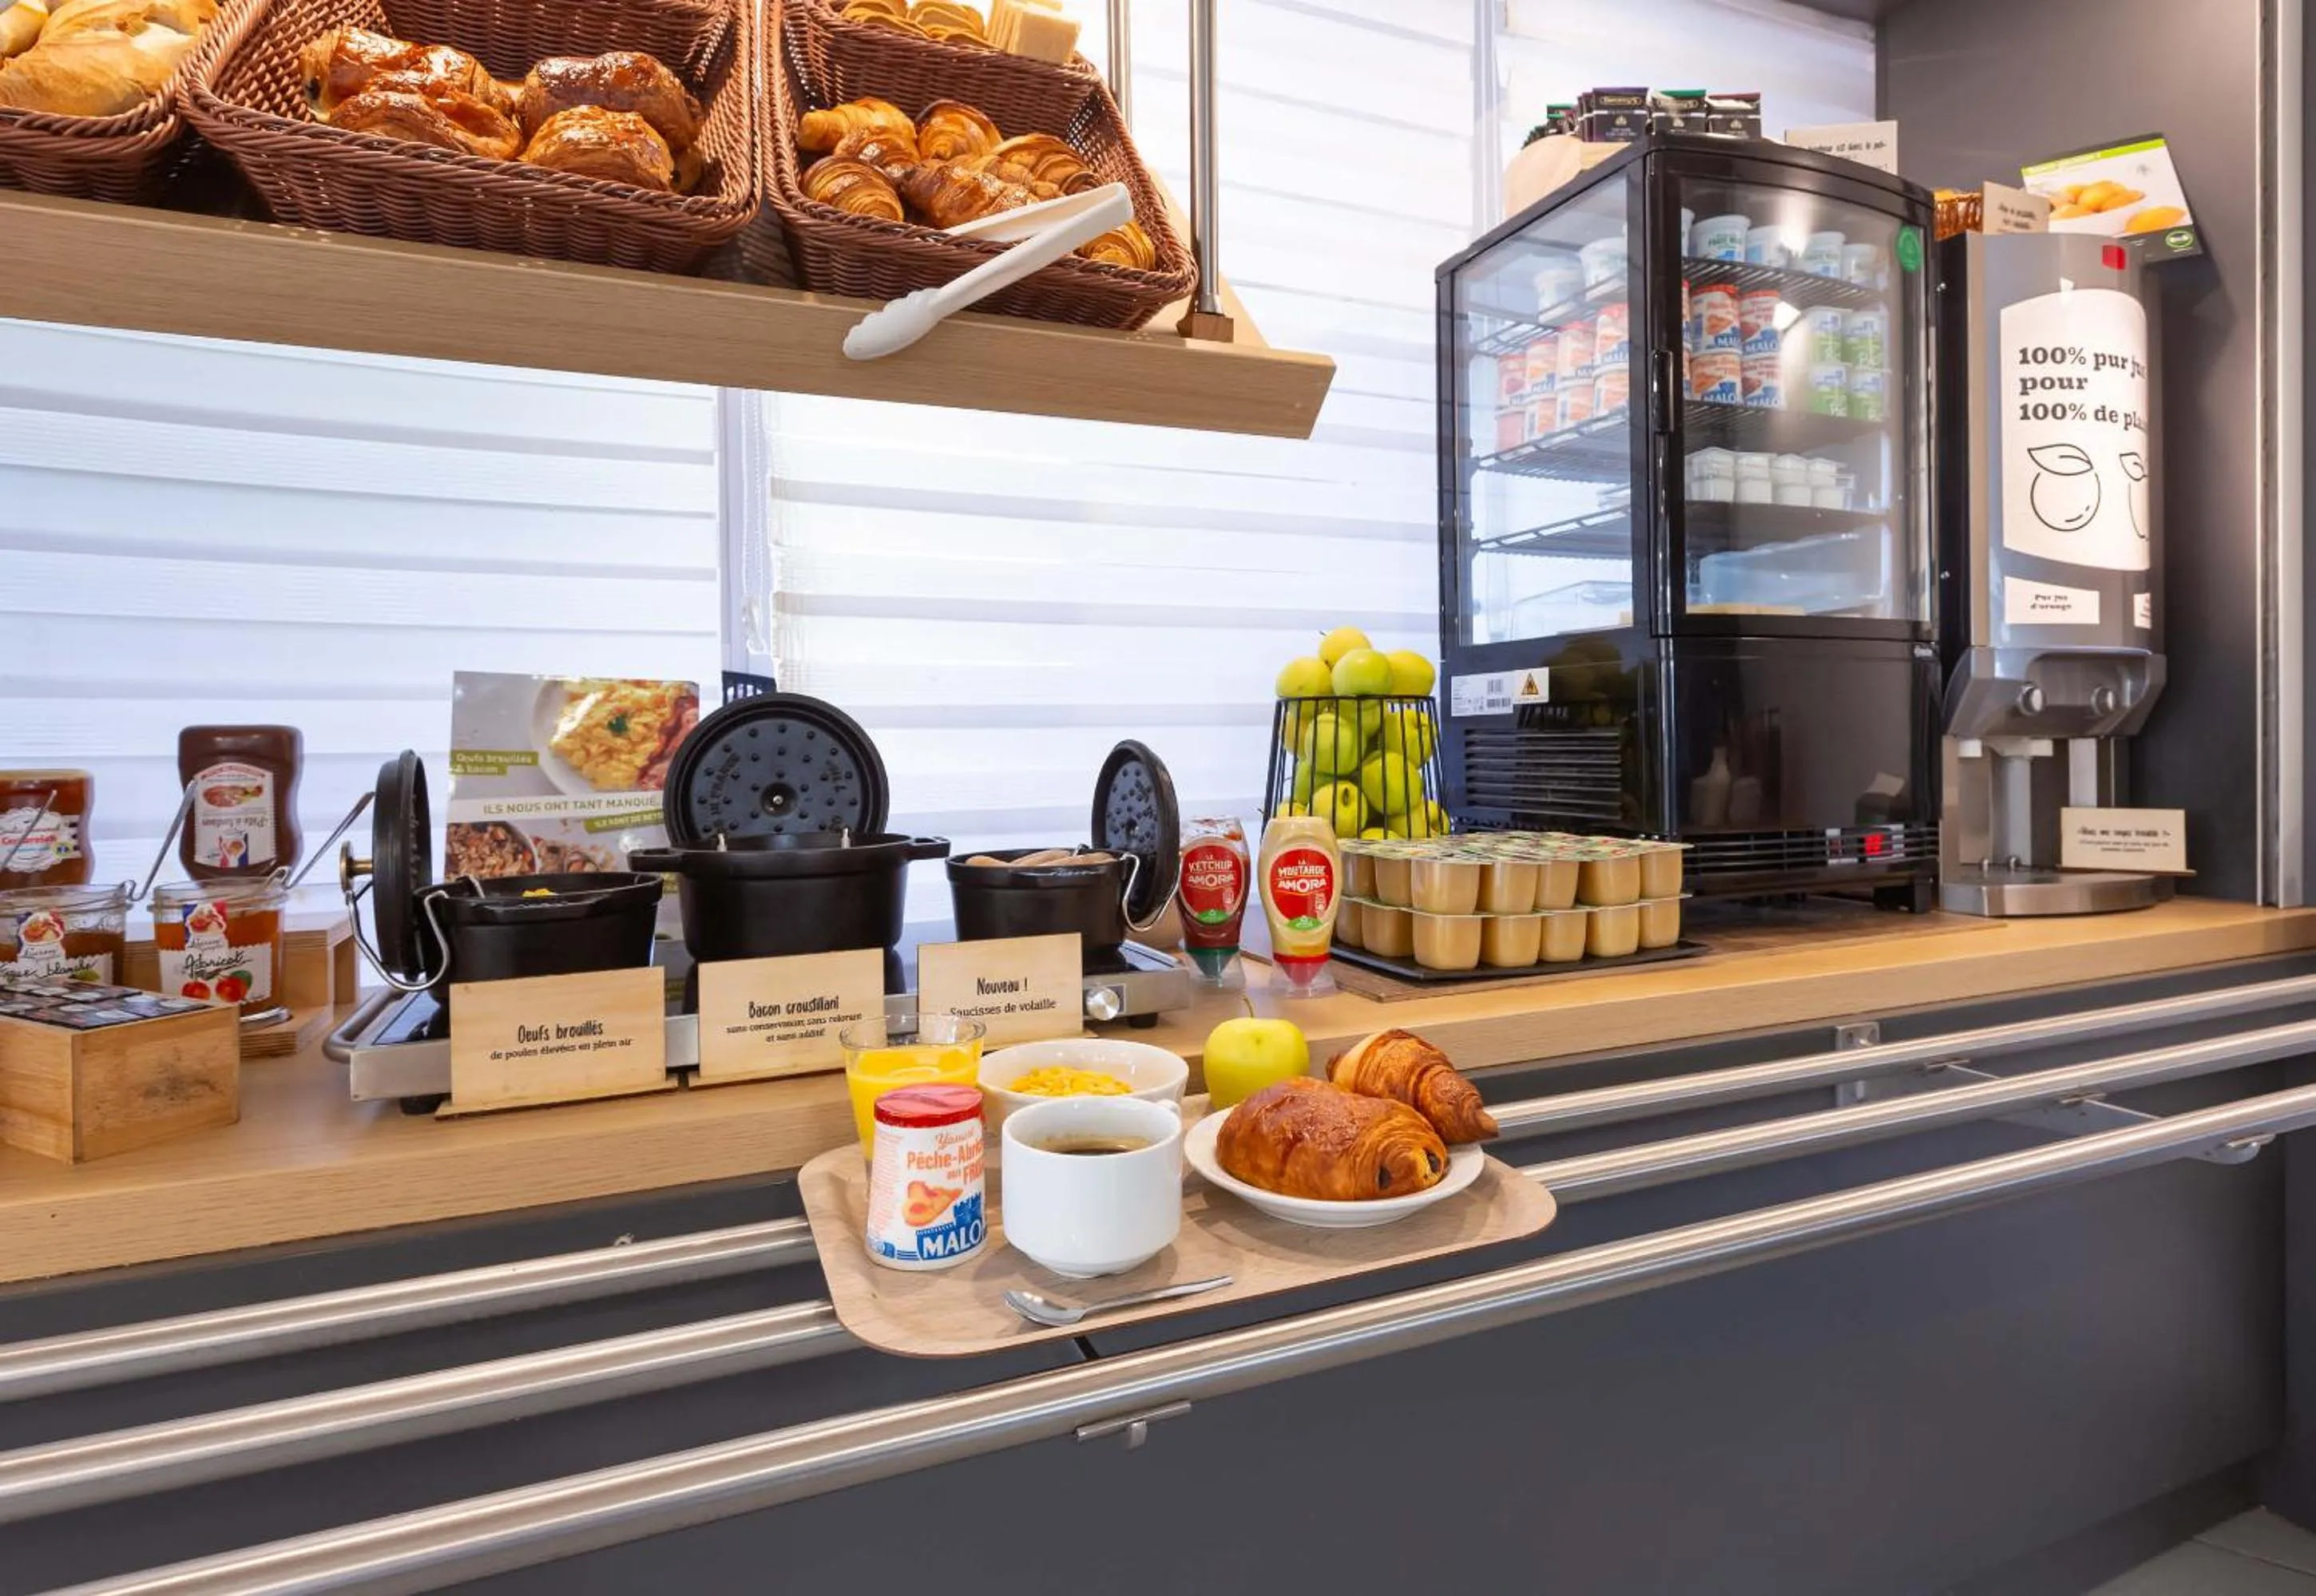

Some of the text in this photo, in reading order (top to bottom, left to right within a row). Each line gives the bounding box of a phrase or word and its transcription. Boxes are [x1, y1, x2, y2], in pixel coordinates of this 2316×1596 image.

[2018, 346, 2087, 366] 100%
[2092, 351, 2128, 371] pur
[2018, 376, 2088, 396] pour
[2018, 402, 2088, 421] 100%
[2093, 404, 2120, 424] de
[483, 803, 504, 814] ILS
[506, 802, 541, 814] NOUS
[544, 801, 569, 812] ONT
[573, 799, 603, 810] TANT
[1188, 861, 1233, 873] KETCHUP
[1278, 865, 1327, 877] MOUTARDE
[1188, 873, 1235, 887] AMORA
[1278, 878, 1327, 893] AMORA
[184, 949, 246, 979] Abricot
[977, 976, 1019, 996] Nouveau
[748, 996, 839, 1019] Bacon croustillant
[950, 998, 1057, 1018] Saucisses de volaille
[518, 1019, 604, 1044] Oeufs brouillés
[807, 1017, 827, 1026] sans
[490, 1050, 502, 1061] de
[505, 1047, 538, 1061] poules
[593, 1040, 617, 1051] plein
[619, 1038, 632, 1047] air
[922, 1218, 982, 1260] MALO
